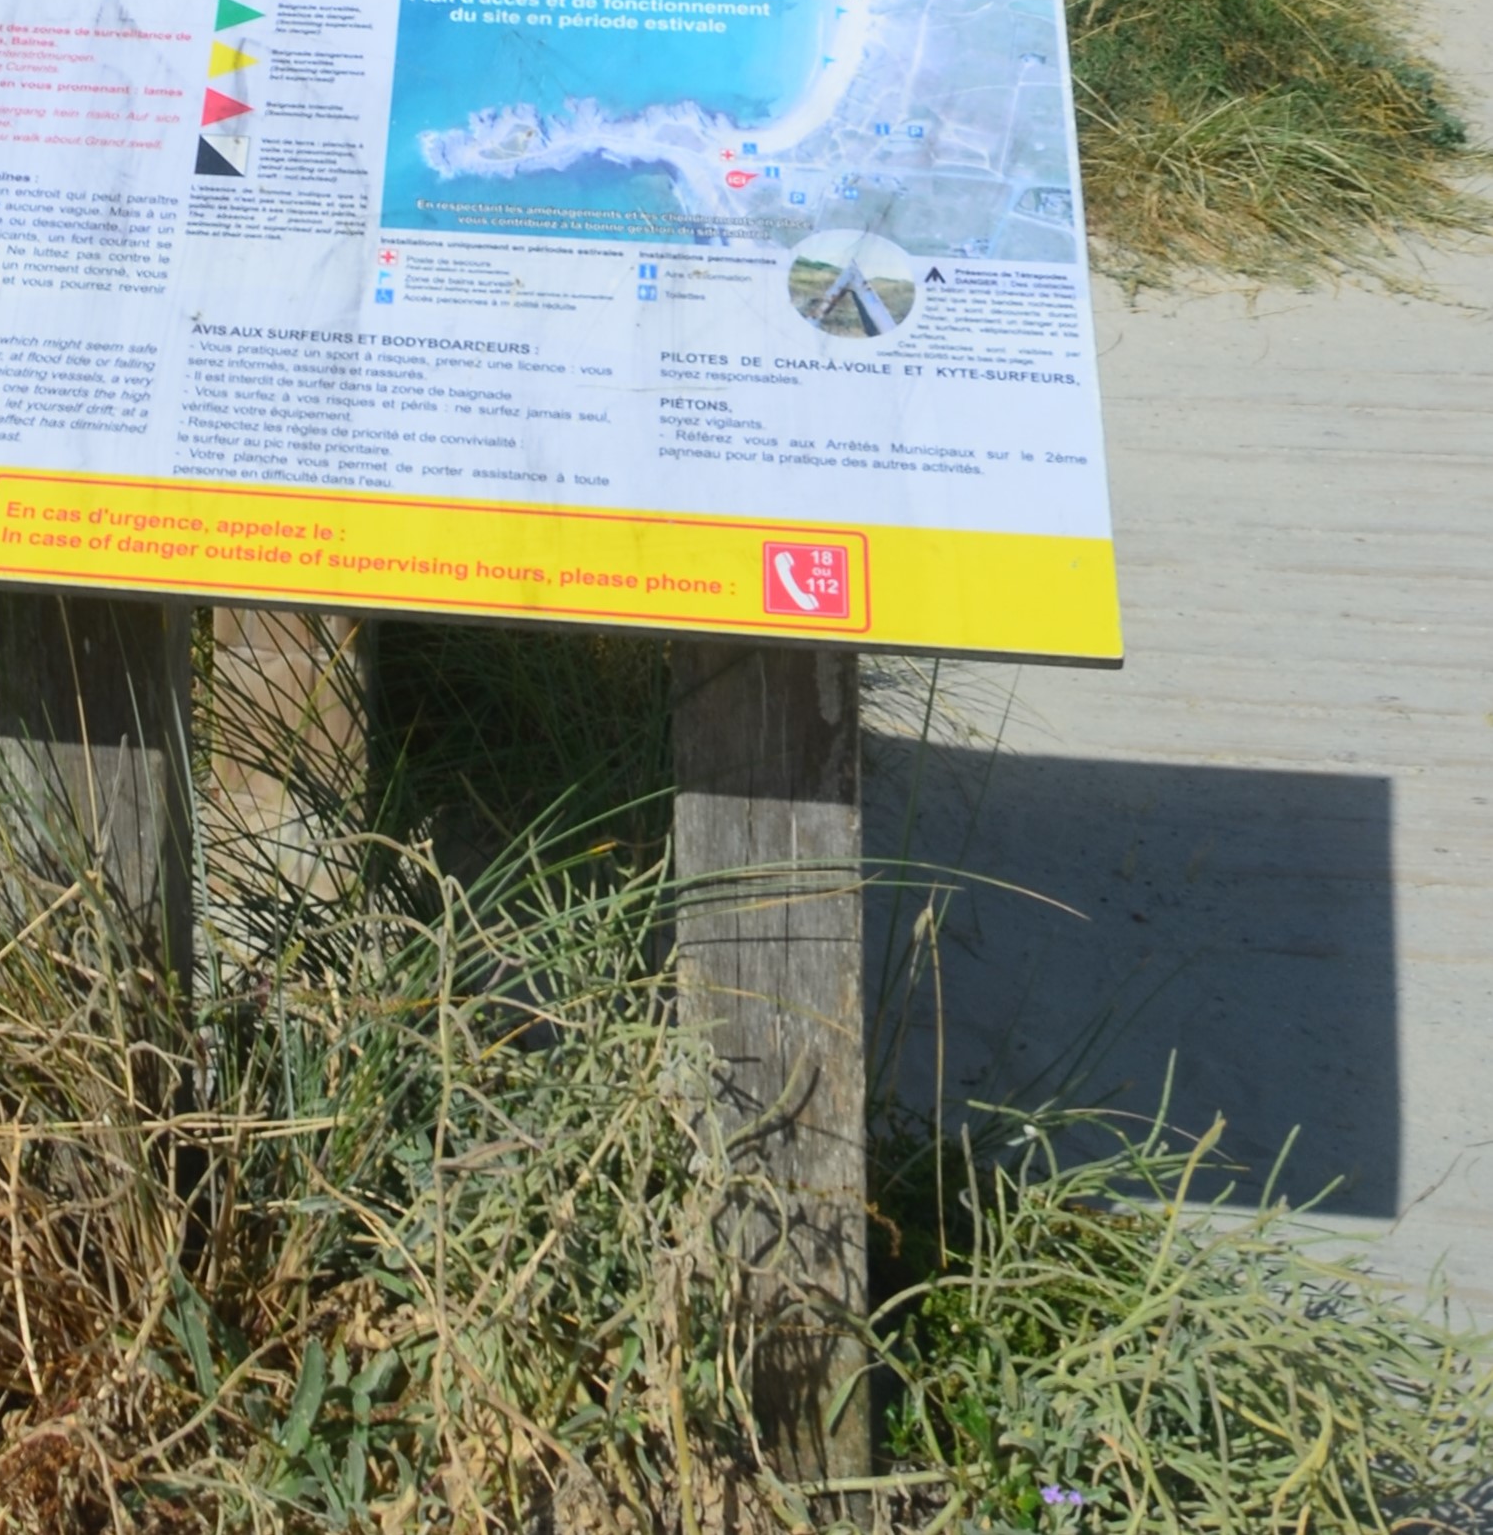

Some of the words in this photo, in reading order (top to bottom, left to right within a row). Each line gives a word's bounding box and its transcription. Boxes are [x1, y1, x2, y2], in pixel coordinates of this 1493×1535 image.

[449, 7, 477, 22] du
[482, 9, 521, 24] site
[525, 13, 552, 25] en
[558, 13, 638, 29] période
[644, 17, 726, 33] estivale
[191, 323, 227, 336] AVIS
[229, 326, 262, 338] AUX
[267, 328, 353, 343] SURFEURS
[357, 333, 376, 344] ET
[381, 335, 530, 355] BODYBOARDEURS
[660, 351, 728, 366] PILOTES
[740, 355, 761, 367] DE
[774, 357, 891, 375] CHAR-À-VOILE
[903, 364, 923, 376] ET
[936, 367, 1080, 386] KYTE-SURFEURS,
[660, 368, 700, 380] soyez
[705, 371, 800, 385] responsables.
[660, 397, 732, 412] PIÉTONS,
[659, 415, 700, 427] soyez
[705, 418, 764, 430] vigilants.
[675, 428, 732, 444] Référez
[743, 436, 778, 447] vous
[789, 439, 815, 449] aux
[826, 438, 880, 453] Arrêtés
[890, 442, 975, 458] Municipaux
[986, 450, 1010, 460] sur
[1020, 450, 1034, 462] le
[1045, 451, 1087, 464] 2ème
[659, 447, 721, 459] panneau
[725, 450, 757, 461] pour
[762, 451, 774, 462] la
[778, 454, 837, 466] pratique
[841, 456, 868, 468] des
[872, 459, 917, 471] autres
[921, 463, 984, 475] activités.
[6, 501, 36, 519] En
[41, 507, 81, 523] cas
[87, 507, 209, 533] d'urgence,
[216, 520, 306, 539] appelez
[313, 523, 334, 541] le
[1, 527, 22, 543] In
[28, 532, 82, 548] case
[87, 534, 112, 550] of
[117, 535, 199, 559] danger
[204, 545, 292, 564] outside
[298, 549, 323, 565] of
[328, 554, 468, 581] supervising
[476, 561, 551, 584] hours,
[559, 568, 638, 588] please
[645, 574, 722, 595] phone
[812, 550, 832, 565] 18
[812, 567, 831, 577] ou
[804, 577, 838, 595] 112
